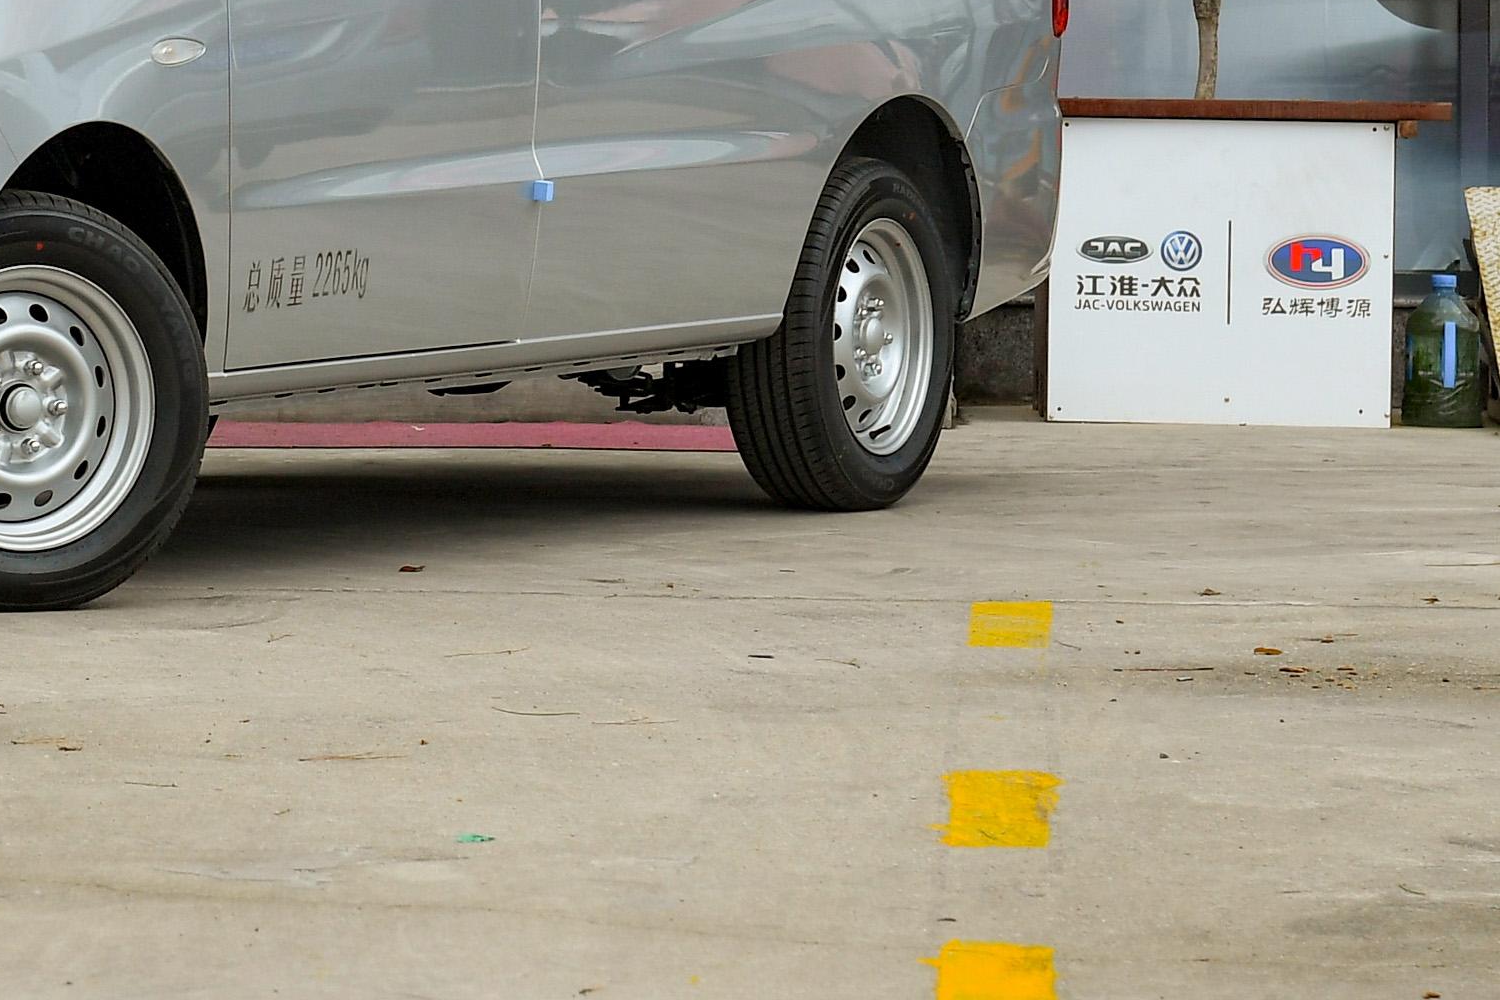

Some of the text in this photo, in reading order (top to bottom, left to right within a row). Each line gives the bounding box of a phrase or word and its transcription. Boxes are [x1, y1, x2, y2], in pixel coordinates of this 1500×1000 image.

[1086, 240, 1142, 255] JAC
[1076, 274, 1201, 297] 江淮-大众
[1074, 299, 1201, 312] JAC-VOLKSWAGEN
[1261, 297, 1371, 318] 弘辉博源
